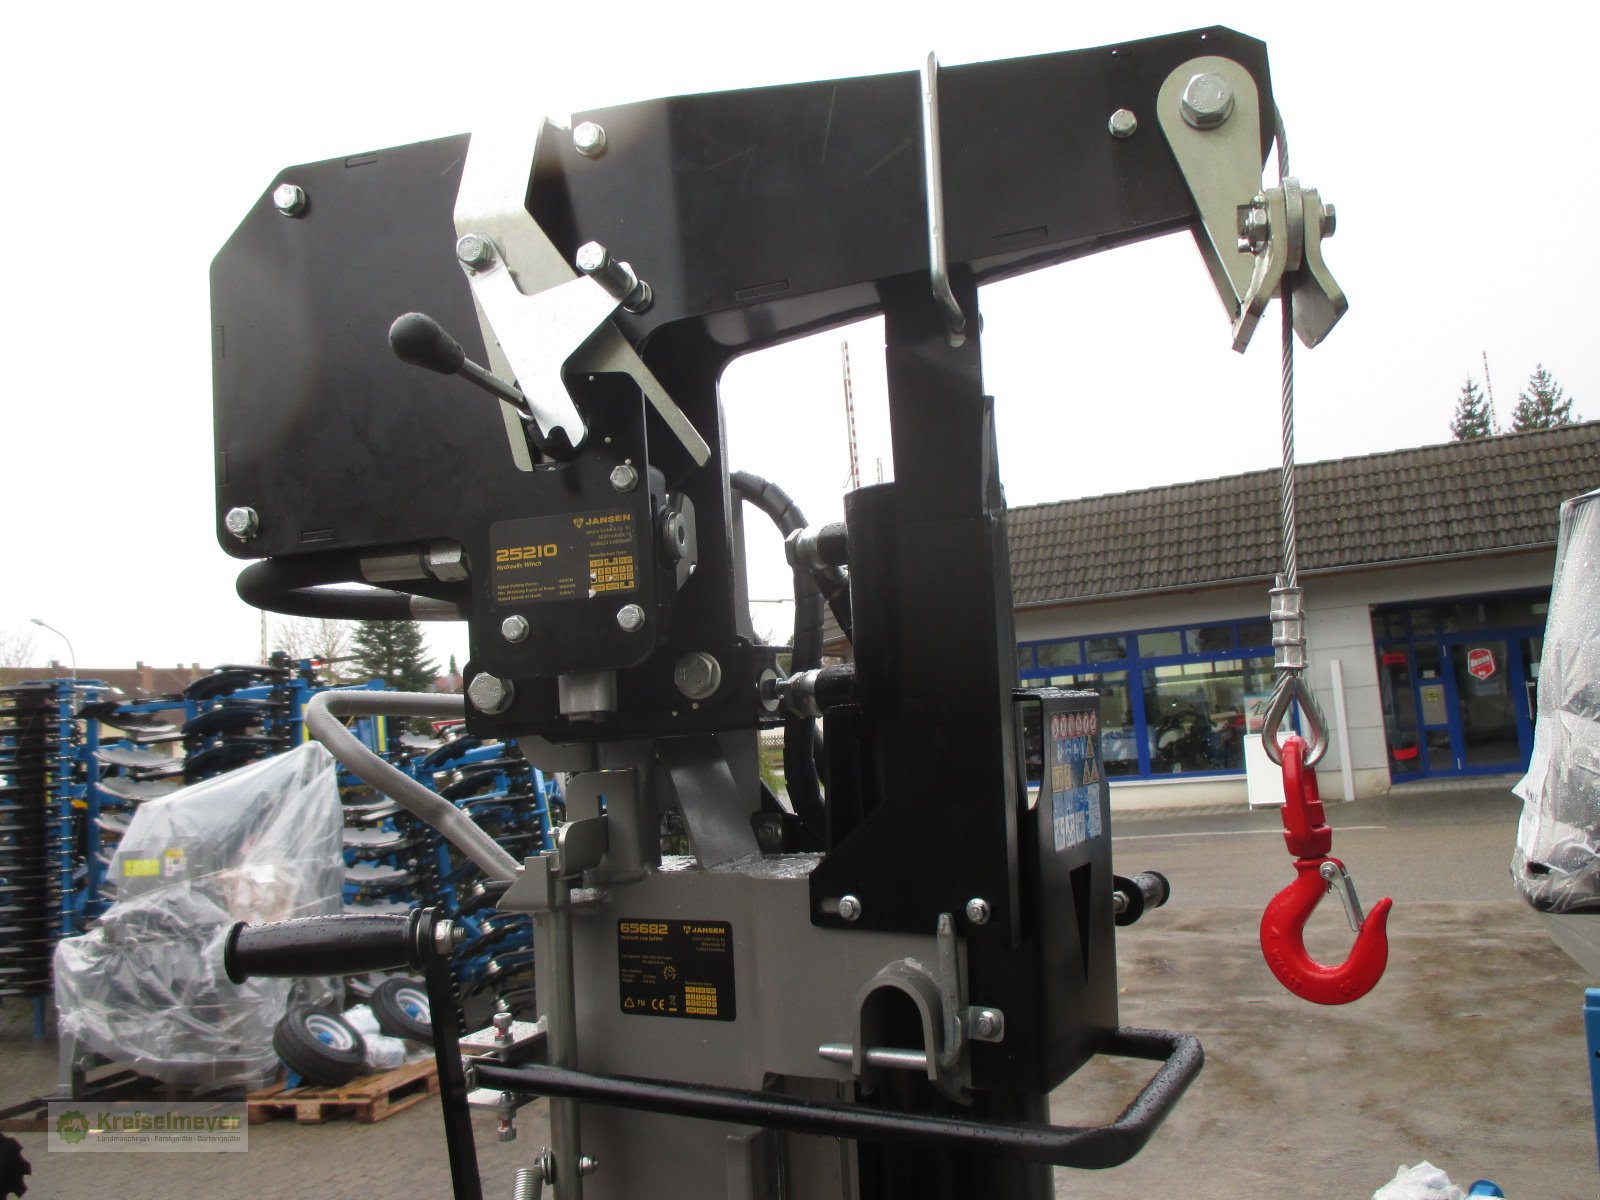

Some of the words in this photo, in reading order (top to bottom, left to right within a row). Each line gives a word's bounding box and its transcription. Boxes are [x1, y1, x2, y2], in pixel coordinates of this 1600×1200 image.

[585, 514, 631, 526] JANSEN
[496, 543, 558, 562] 25210
[496, 562, 523, 571] Hydraulic
[524, 560, 542, 568] Winch
[620, 923, 669, 934] 65682
